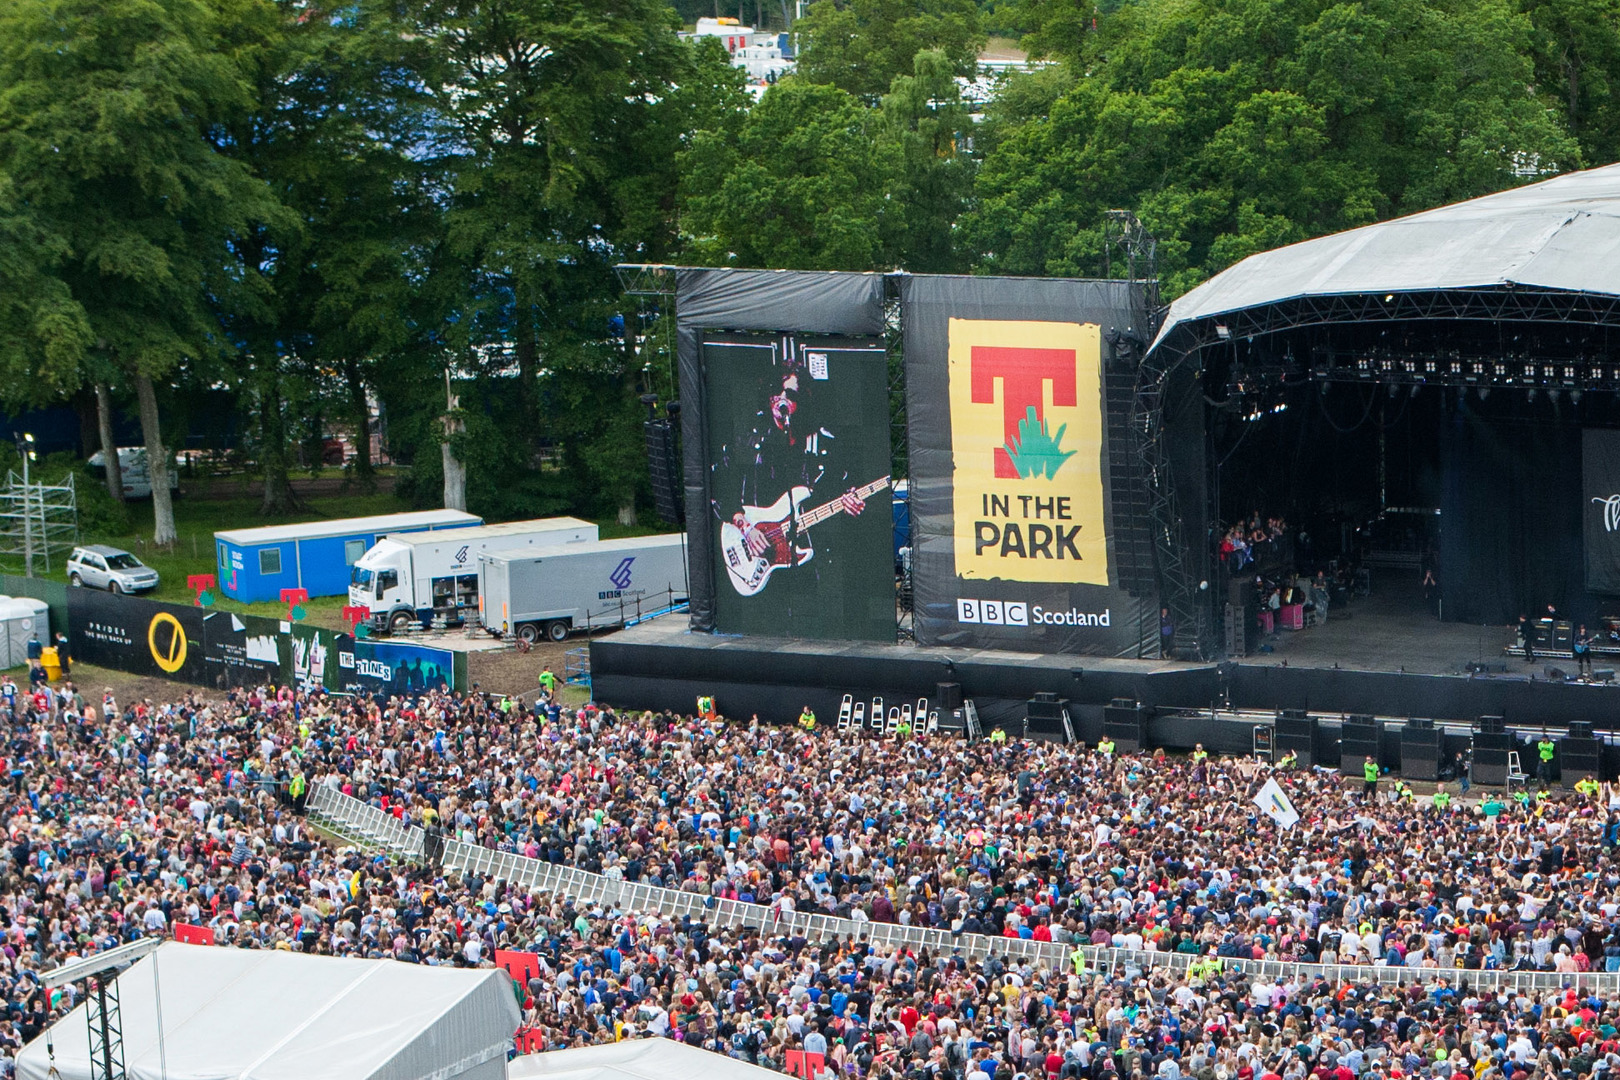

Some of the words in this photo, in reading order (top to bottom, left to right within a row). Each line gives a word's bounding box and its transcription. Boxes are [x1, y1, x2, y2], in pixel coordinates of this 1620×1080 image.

[971, 346, 1077, 479] T
[982, 493, 1009, 518] IN
[1018, 495, 1072, 520] THE
[975, 521, 1083, 561] PARK
[958, 601, 1027, 625] BBC
[1032, 606, 1110, 627] Scotland
[340, 653, 354, 667] THE
